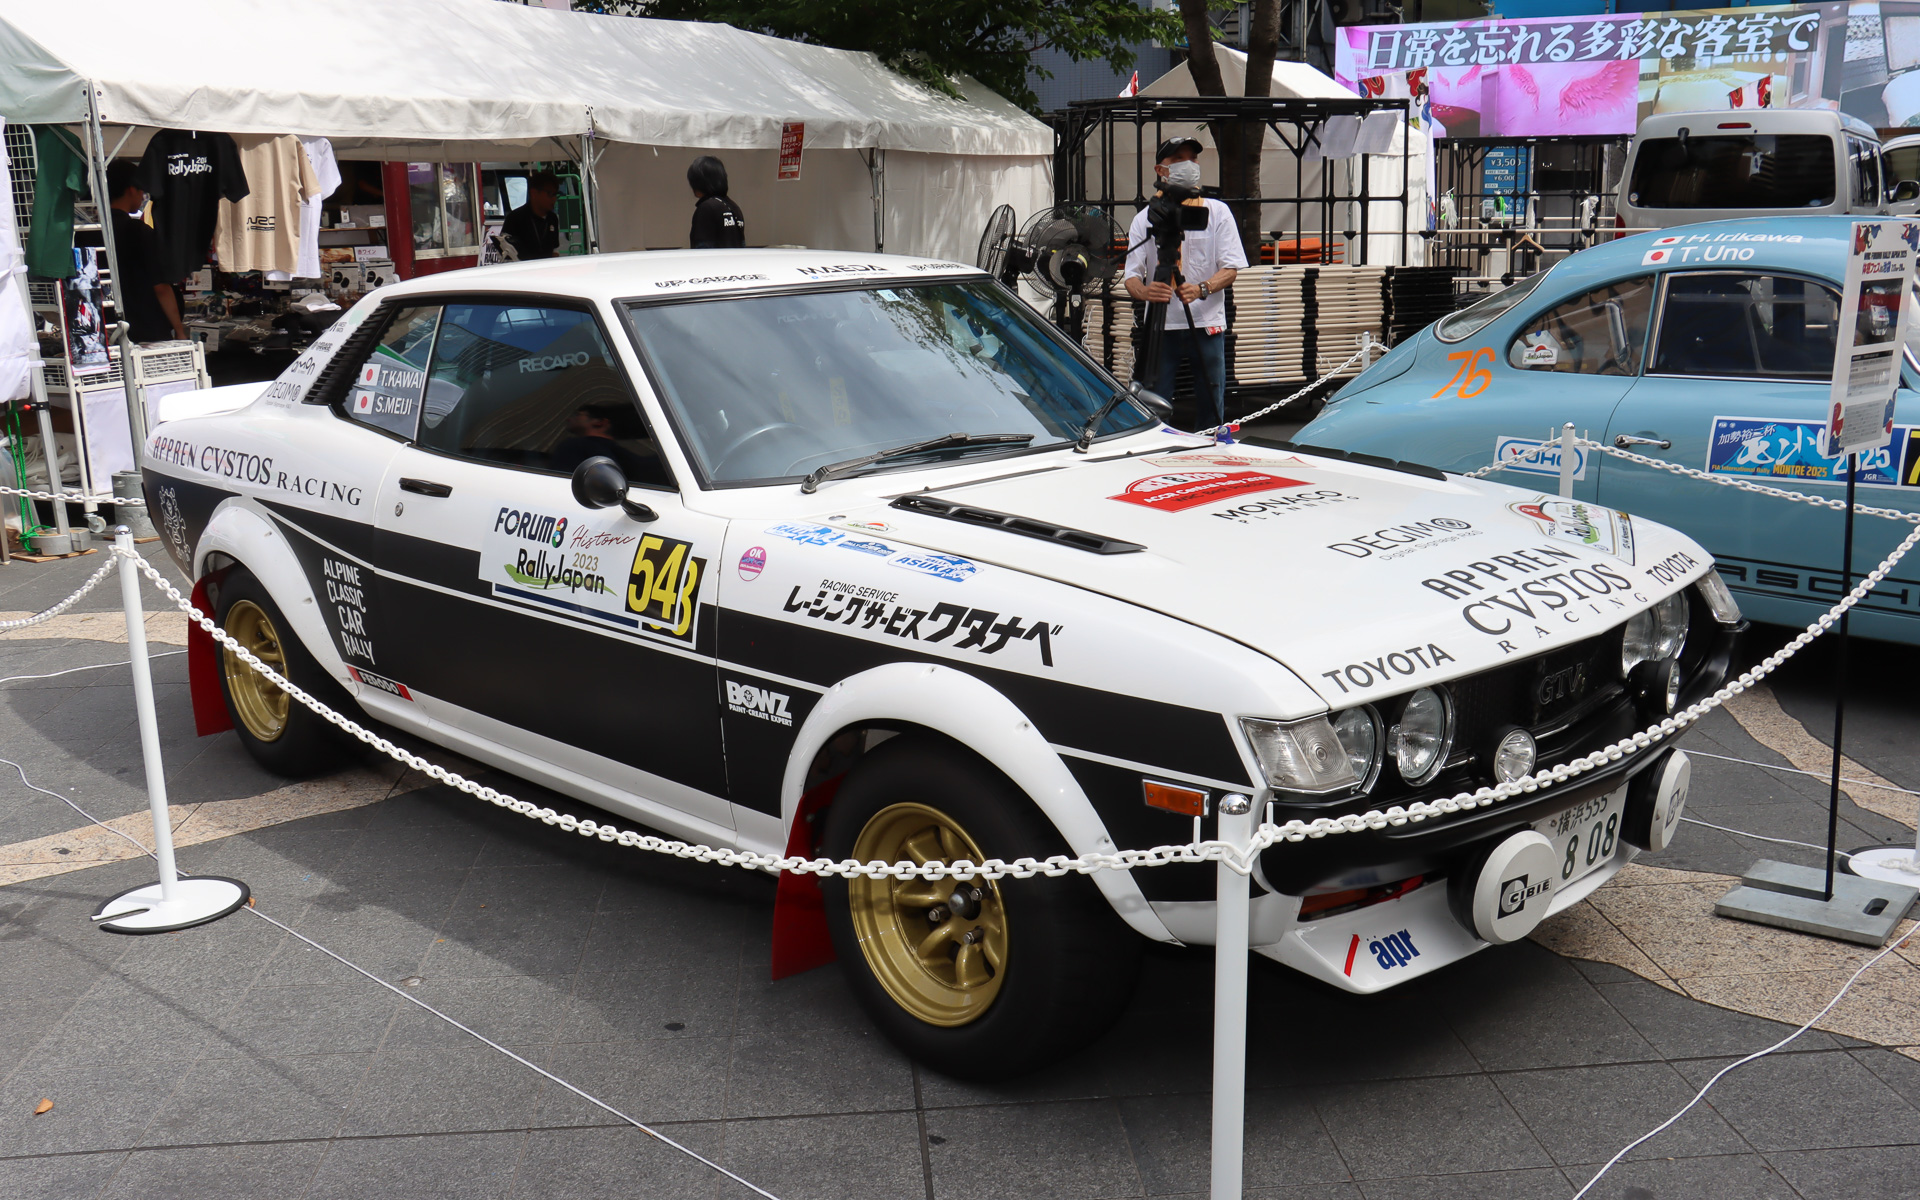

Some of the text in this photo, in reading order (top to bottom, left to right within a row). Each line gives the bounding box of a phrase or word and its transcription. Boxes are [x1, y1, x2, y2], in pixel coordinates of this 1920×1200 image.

[1367, 12, 1822, 68] 日常を忘れる多彩な客室で
[1686, 233, 1803, 243] H.Irikawa
[1680, 245, 1755, 262] T.Uno
[655, 274, 770, 288] UP GARAGE
[797, 264, 888, 275] MAEDA
[519, 352, 589, 373] RECARO
[1430, 347, 1496, 399] 76
[381, 370, 424, 388] T.KAWAI
[375, 397, 412, 415] S.MEIJI
[1718, 424, 1776, 445] 加勢裕二杯
[153, 436, 362, 506] APPREN CVSTOS RACING
[1773, 464, 1805, 476] MONTRE
[1806, 466, 1827, 477] 2025
[1211, 490, 1342, 520] MONACO
[494, 507, 636, 549] FORUM8 Historic
[572, 552, 599, 571] 2023
[750, 548, 763, 558] OK
[323, 558, 361, 586] ALPINE
[516, 548, 605, 595] RallyJapan
[1421, 544, 1581, 600] APPREN
[1646, 551, 1699, 586] TOYOTA
[326, 580, 366, 613] CLASSIC
[820, 579, 899, 602] RACING SERVICE
[1462, 563, 1632, 635] CVSTOS
[338, 605, 366, 636] CAR
[1497, 592, 1648, 654] RACING
[341, 630, 375, 665] RALLY
[1322, 643, 1456, 693] TOYOTA
[358, 671, 399, 695] FERODO
[726, 680, 792, 719] BOWZ
[770, 714, 793, 727] EXPERT
[1510, 880, 1550, 903] CIBIE
